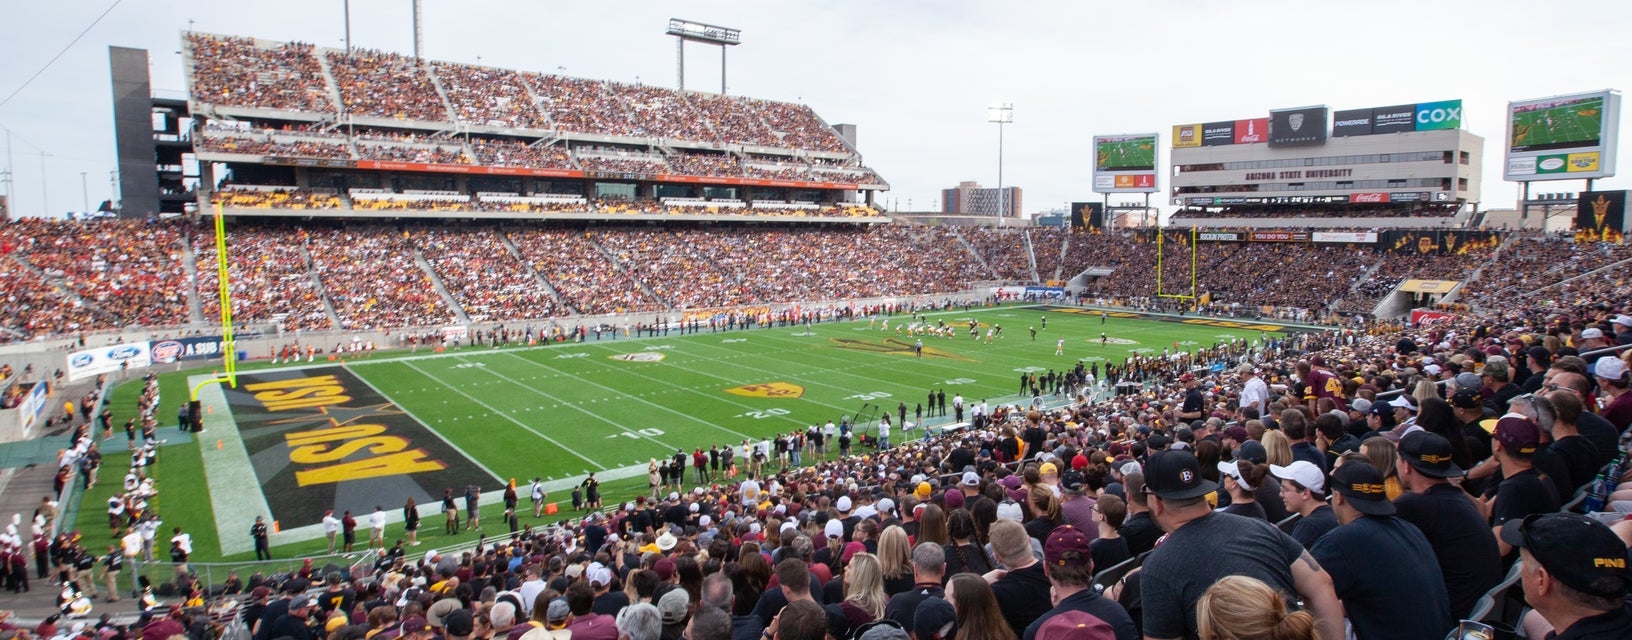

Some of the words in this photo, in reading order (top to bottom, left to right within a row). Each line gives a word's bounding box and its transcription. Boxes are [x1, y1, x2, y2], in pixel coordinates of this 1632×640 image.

[1417, 107, 1460, 124] COX
[1245, 171, 1276, 181] ARIZONA
[1280, 170, 1302, 179] STATE
[1306, 168, 1353, 178] UNIVERSITY
[1356, 193, 1382, 202] Coca-Cola
[186, 344, 194, 355] A
[195, 342, 218, 354] SUB
[745, 408, 791, 419] 20
[621, 427, 664, 439] 10
[285, 423, 448, 487] ASU
[1182, 470, 1191, 482] B
[332, 597, 343, 612] 7
